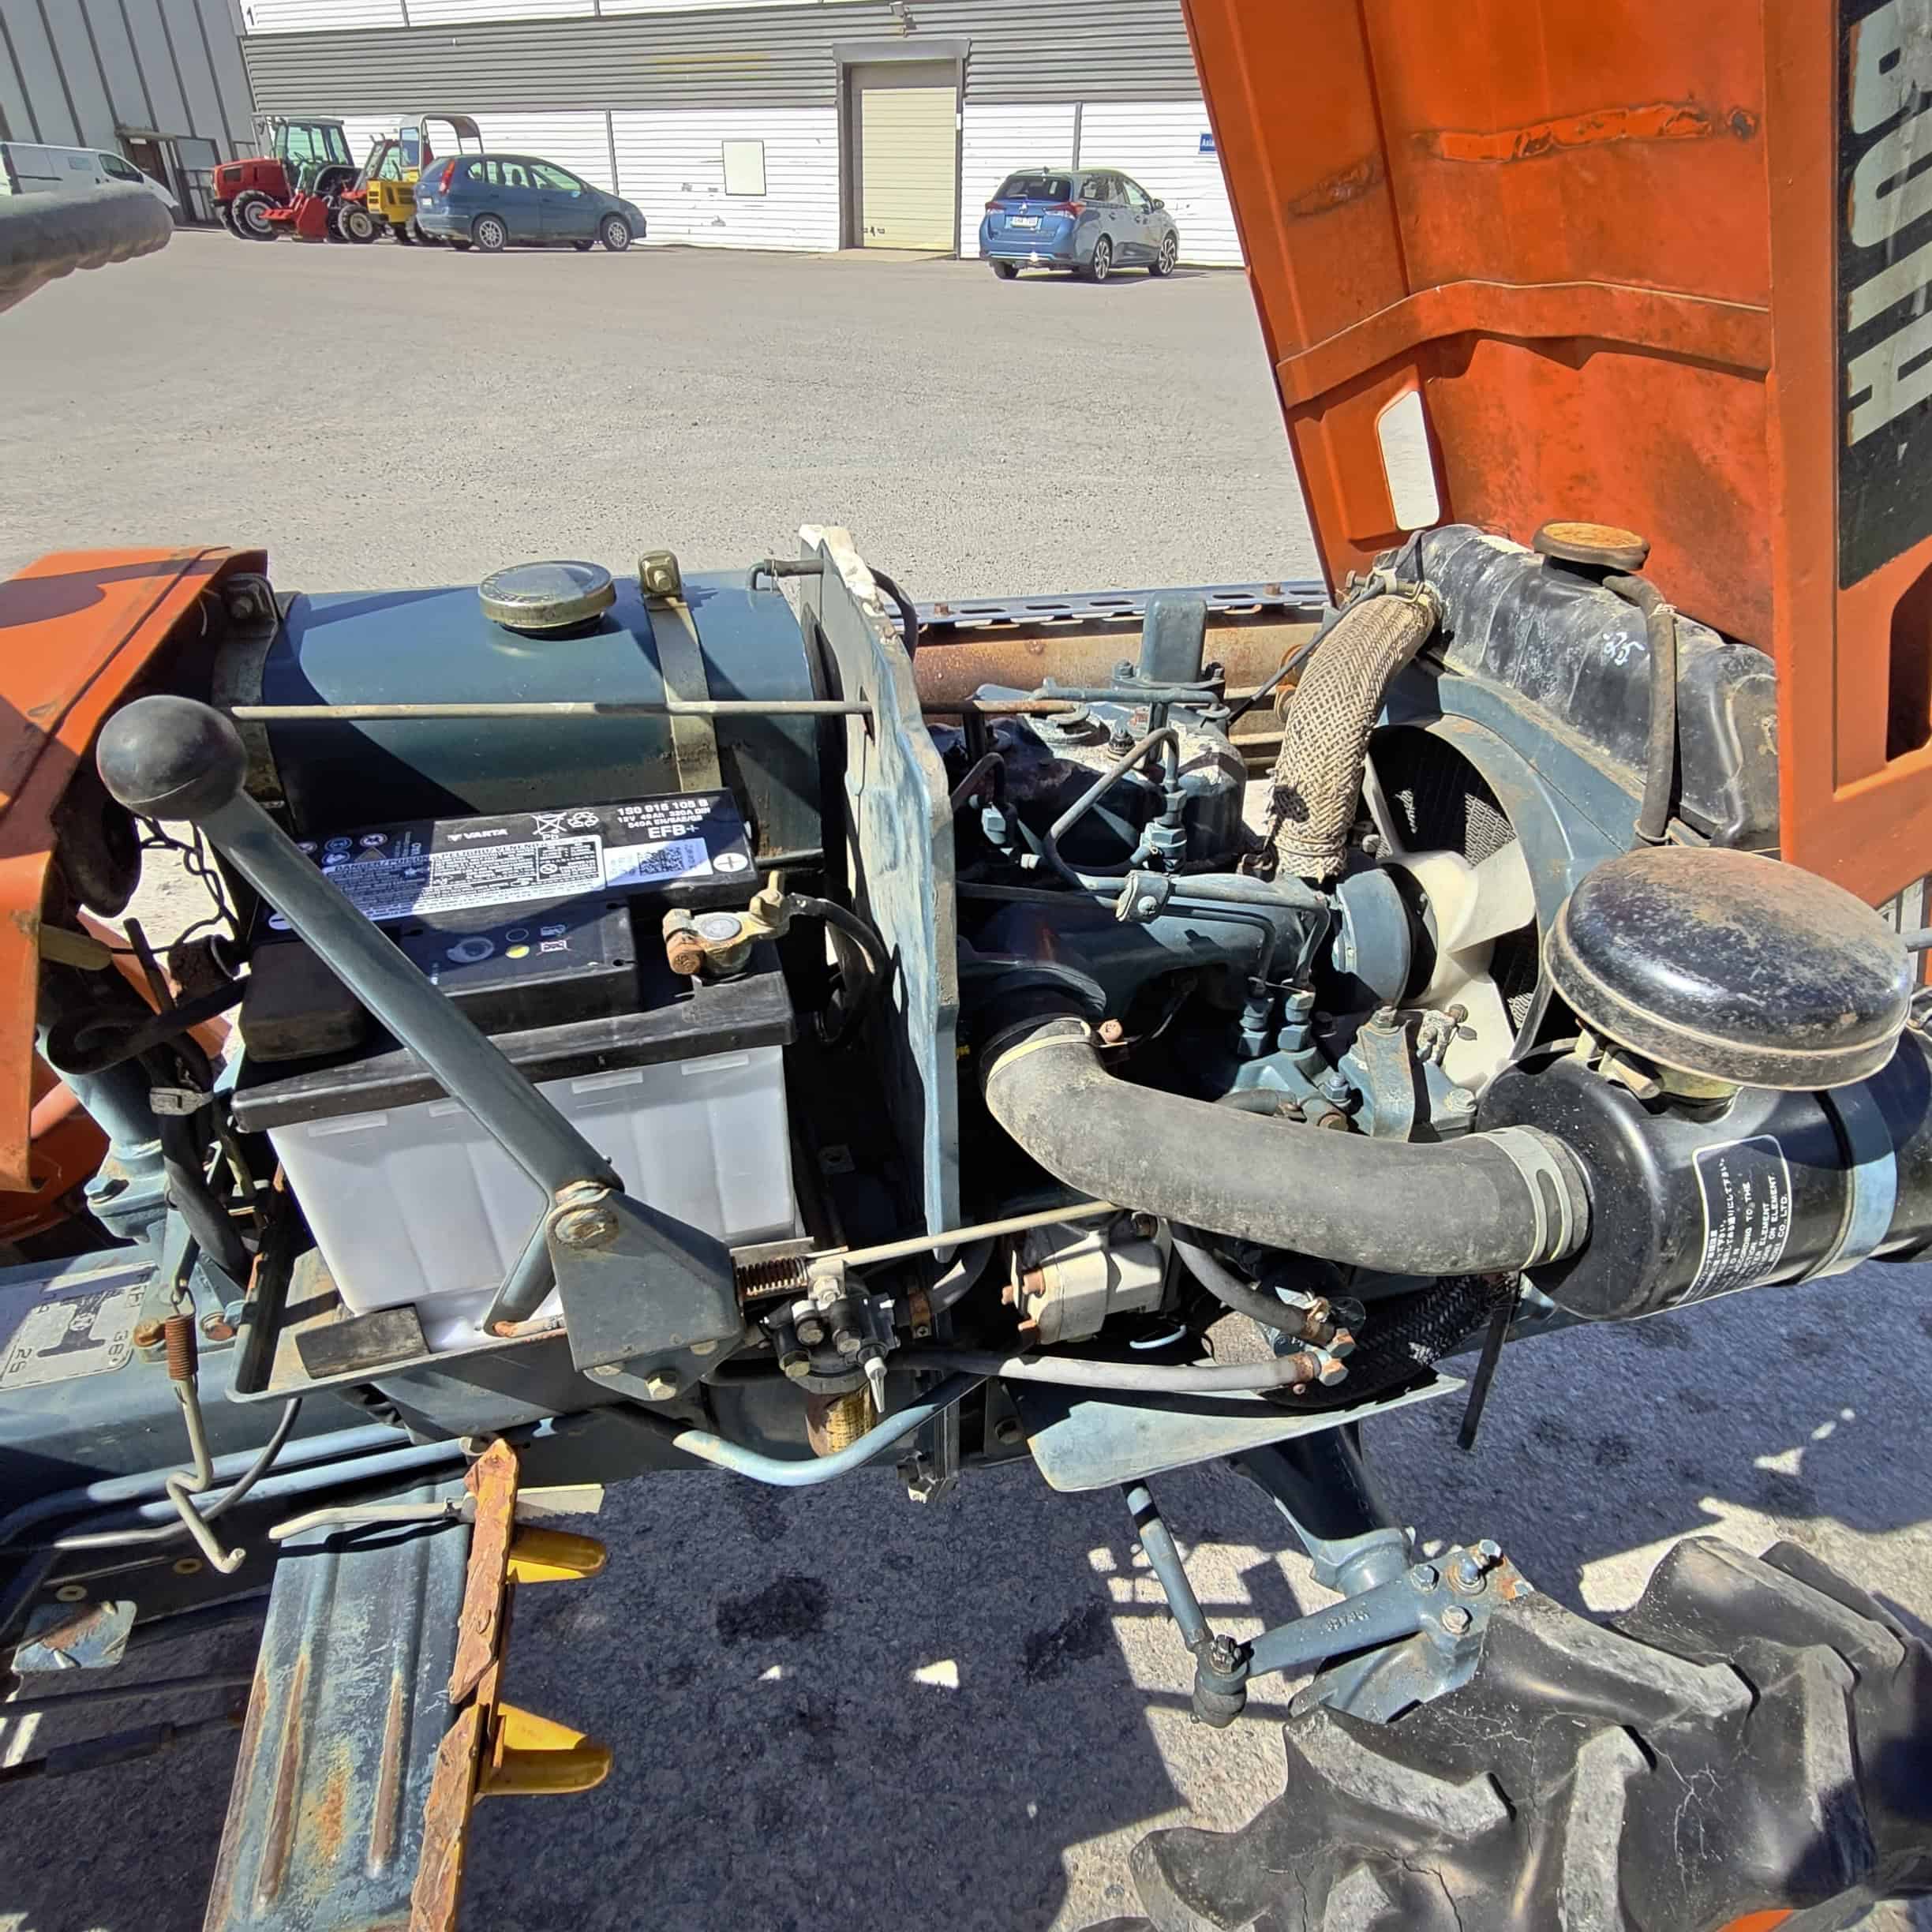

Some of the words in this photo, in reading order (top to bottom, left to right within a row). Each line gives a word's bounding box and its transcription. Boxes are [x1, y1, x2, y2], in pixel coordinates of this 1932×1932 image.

[462, 829, 508, 840] VARTA
[648, 825, 699, 839] EFB+
[1742, 1181, 1751, 1203] THE
